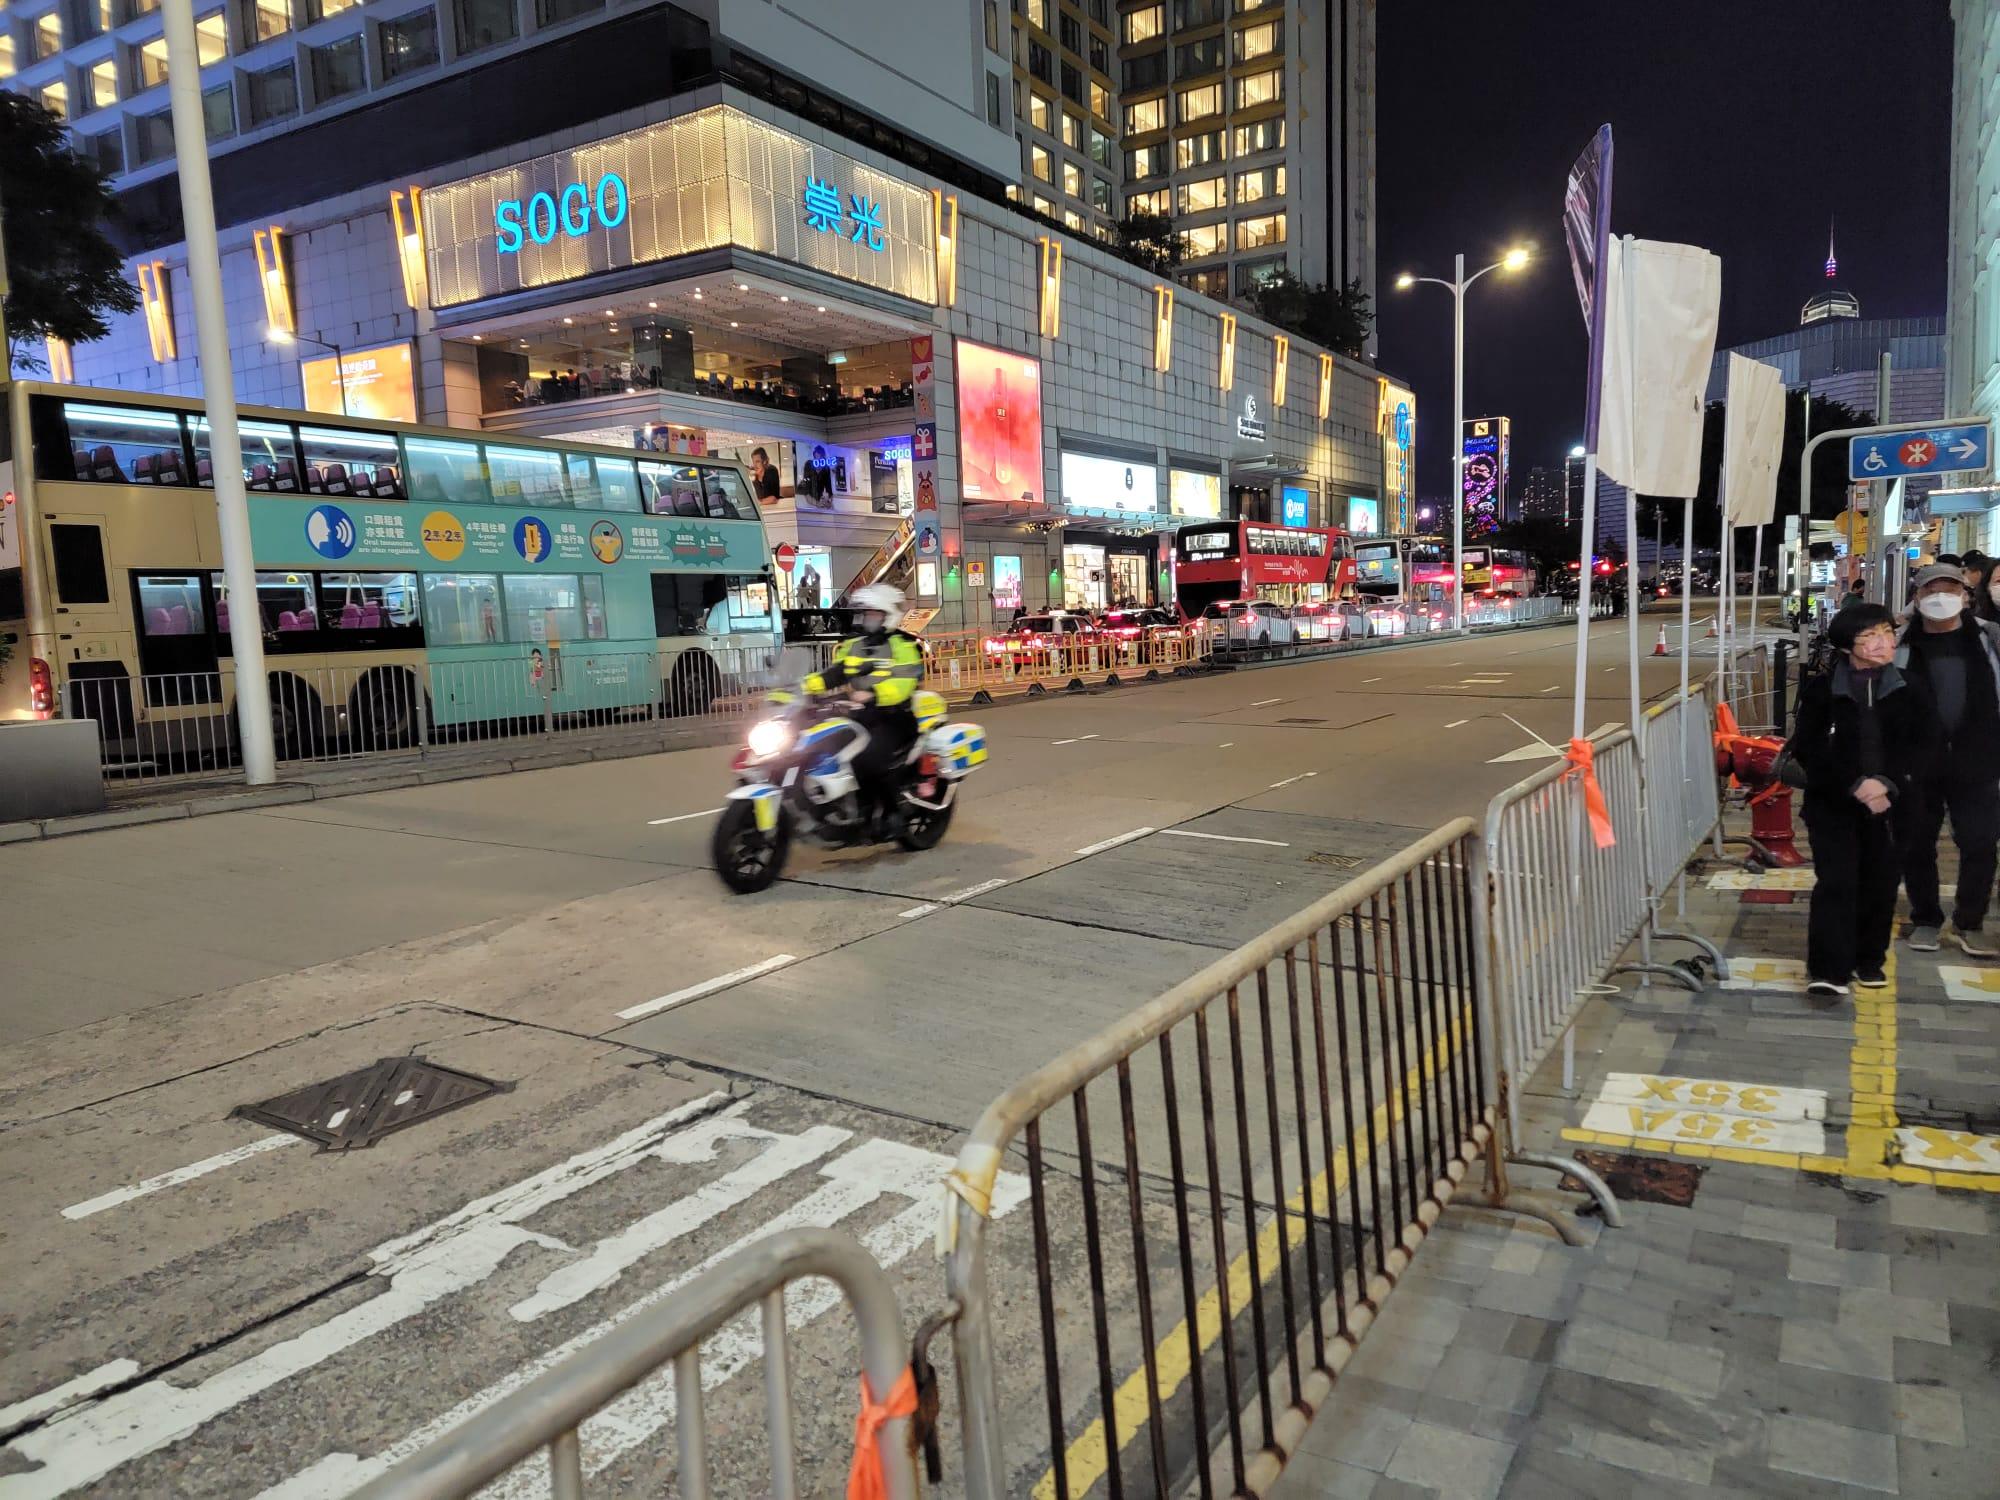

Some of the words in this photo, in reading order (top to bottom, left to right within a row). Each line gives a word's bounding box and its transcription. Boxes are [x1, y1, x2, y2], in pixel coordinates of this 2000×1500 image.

[497, 172, 628, 253] SOGO
[805, 175, 884, 252] 崇光
[363, 538, 379, 546] Oral
[1633, 1076, 1782, 1113] 35X
[1628, 1106, 1777, 1145] 35A
